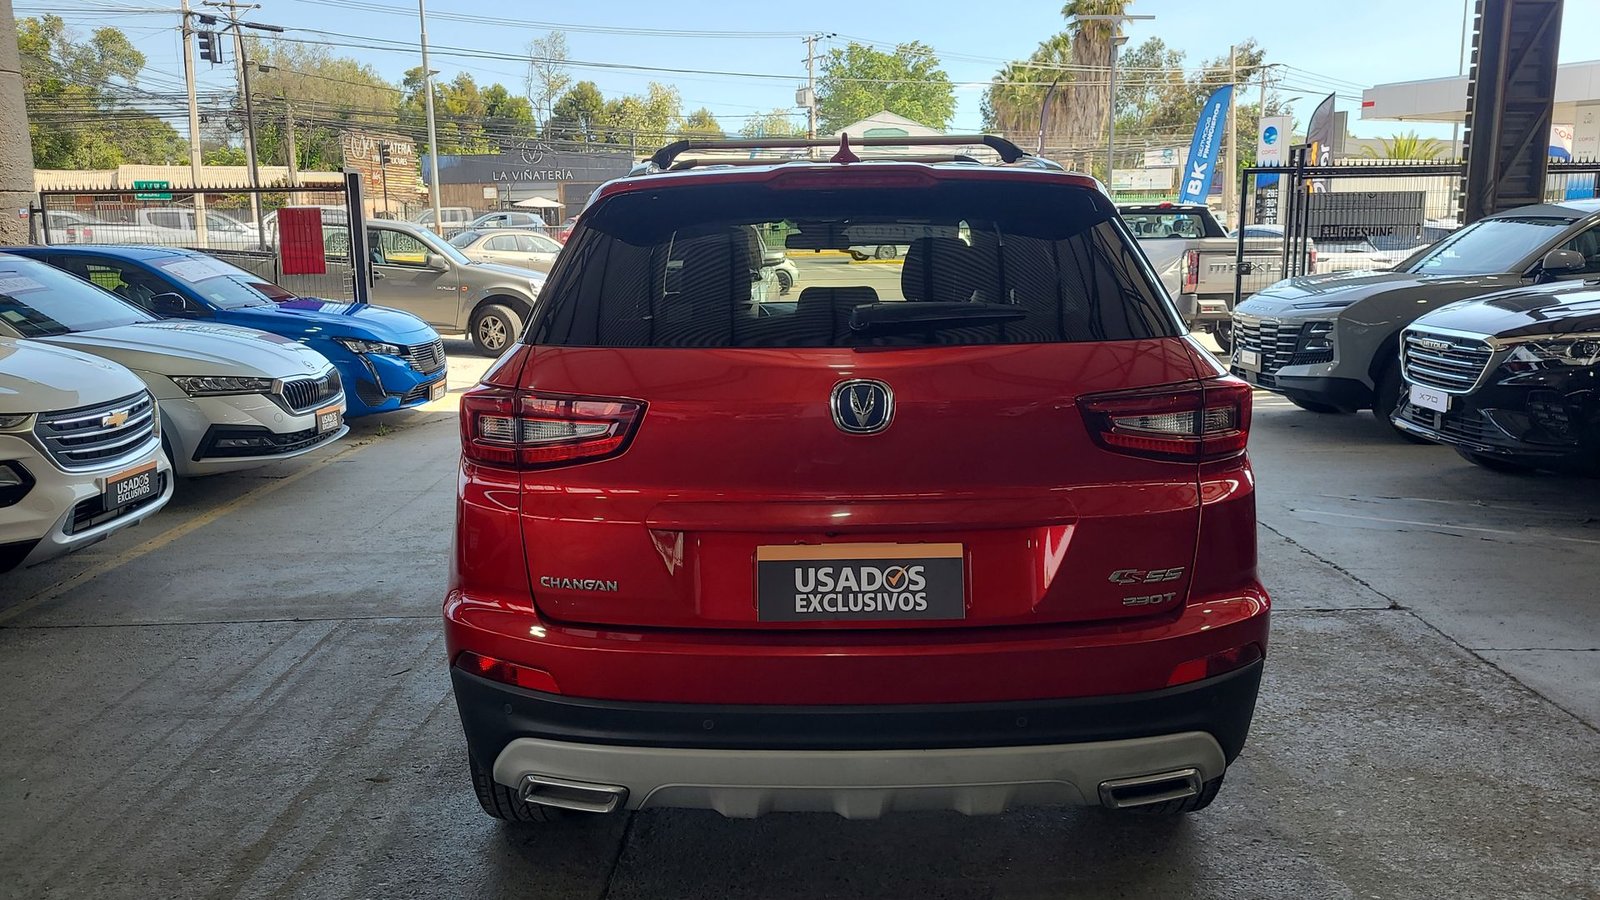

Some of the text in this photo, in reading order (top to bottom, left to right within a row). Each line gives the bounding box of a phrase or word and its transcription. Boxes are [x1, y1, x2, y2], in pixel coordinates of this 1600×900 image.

[1202, 102, 1221, 159] FINANCIEROS
[492, 168, 574, 181] LA VIÑATERÍA
[1187, 161, 1208, 195] BK
[1420, 393, 1438, 404] X70
[117, 473, 150, 495] USADOS
[117, 484, 150, 504] EXCLUSIVOS
[540, 576, 618, 592] CHANGAN
[794, 564, 927, 593] USADOS
[794, 592, 928, 613] EXCLUSIVOS
